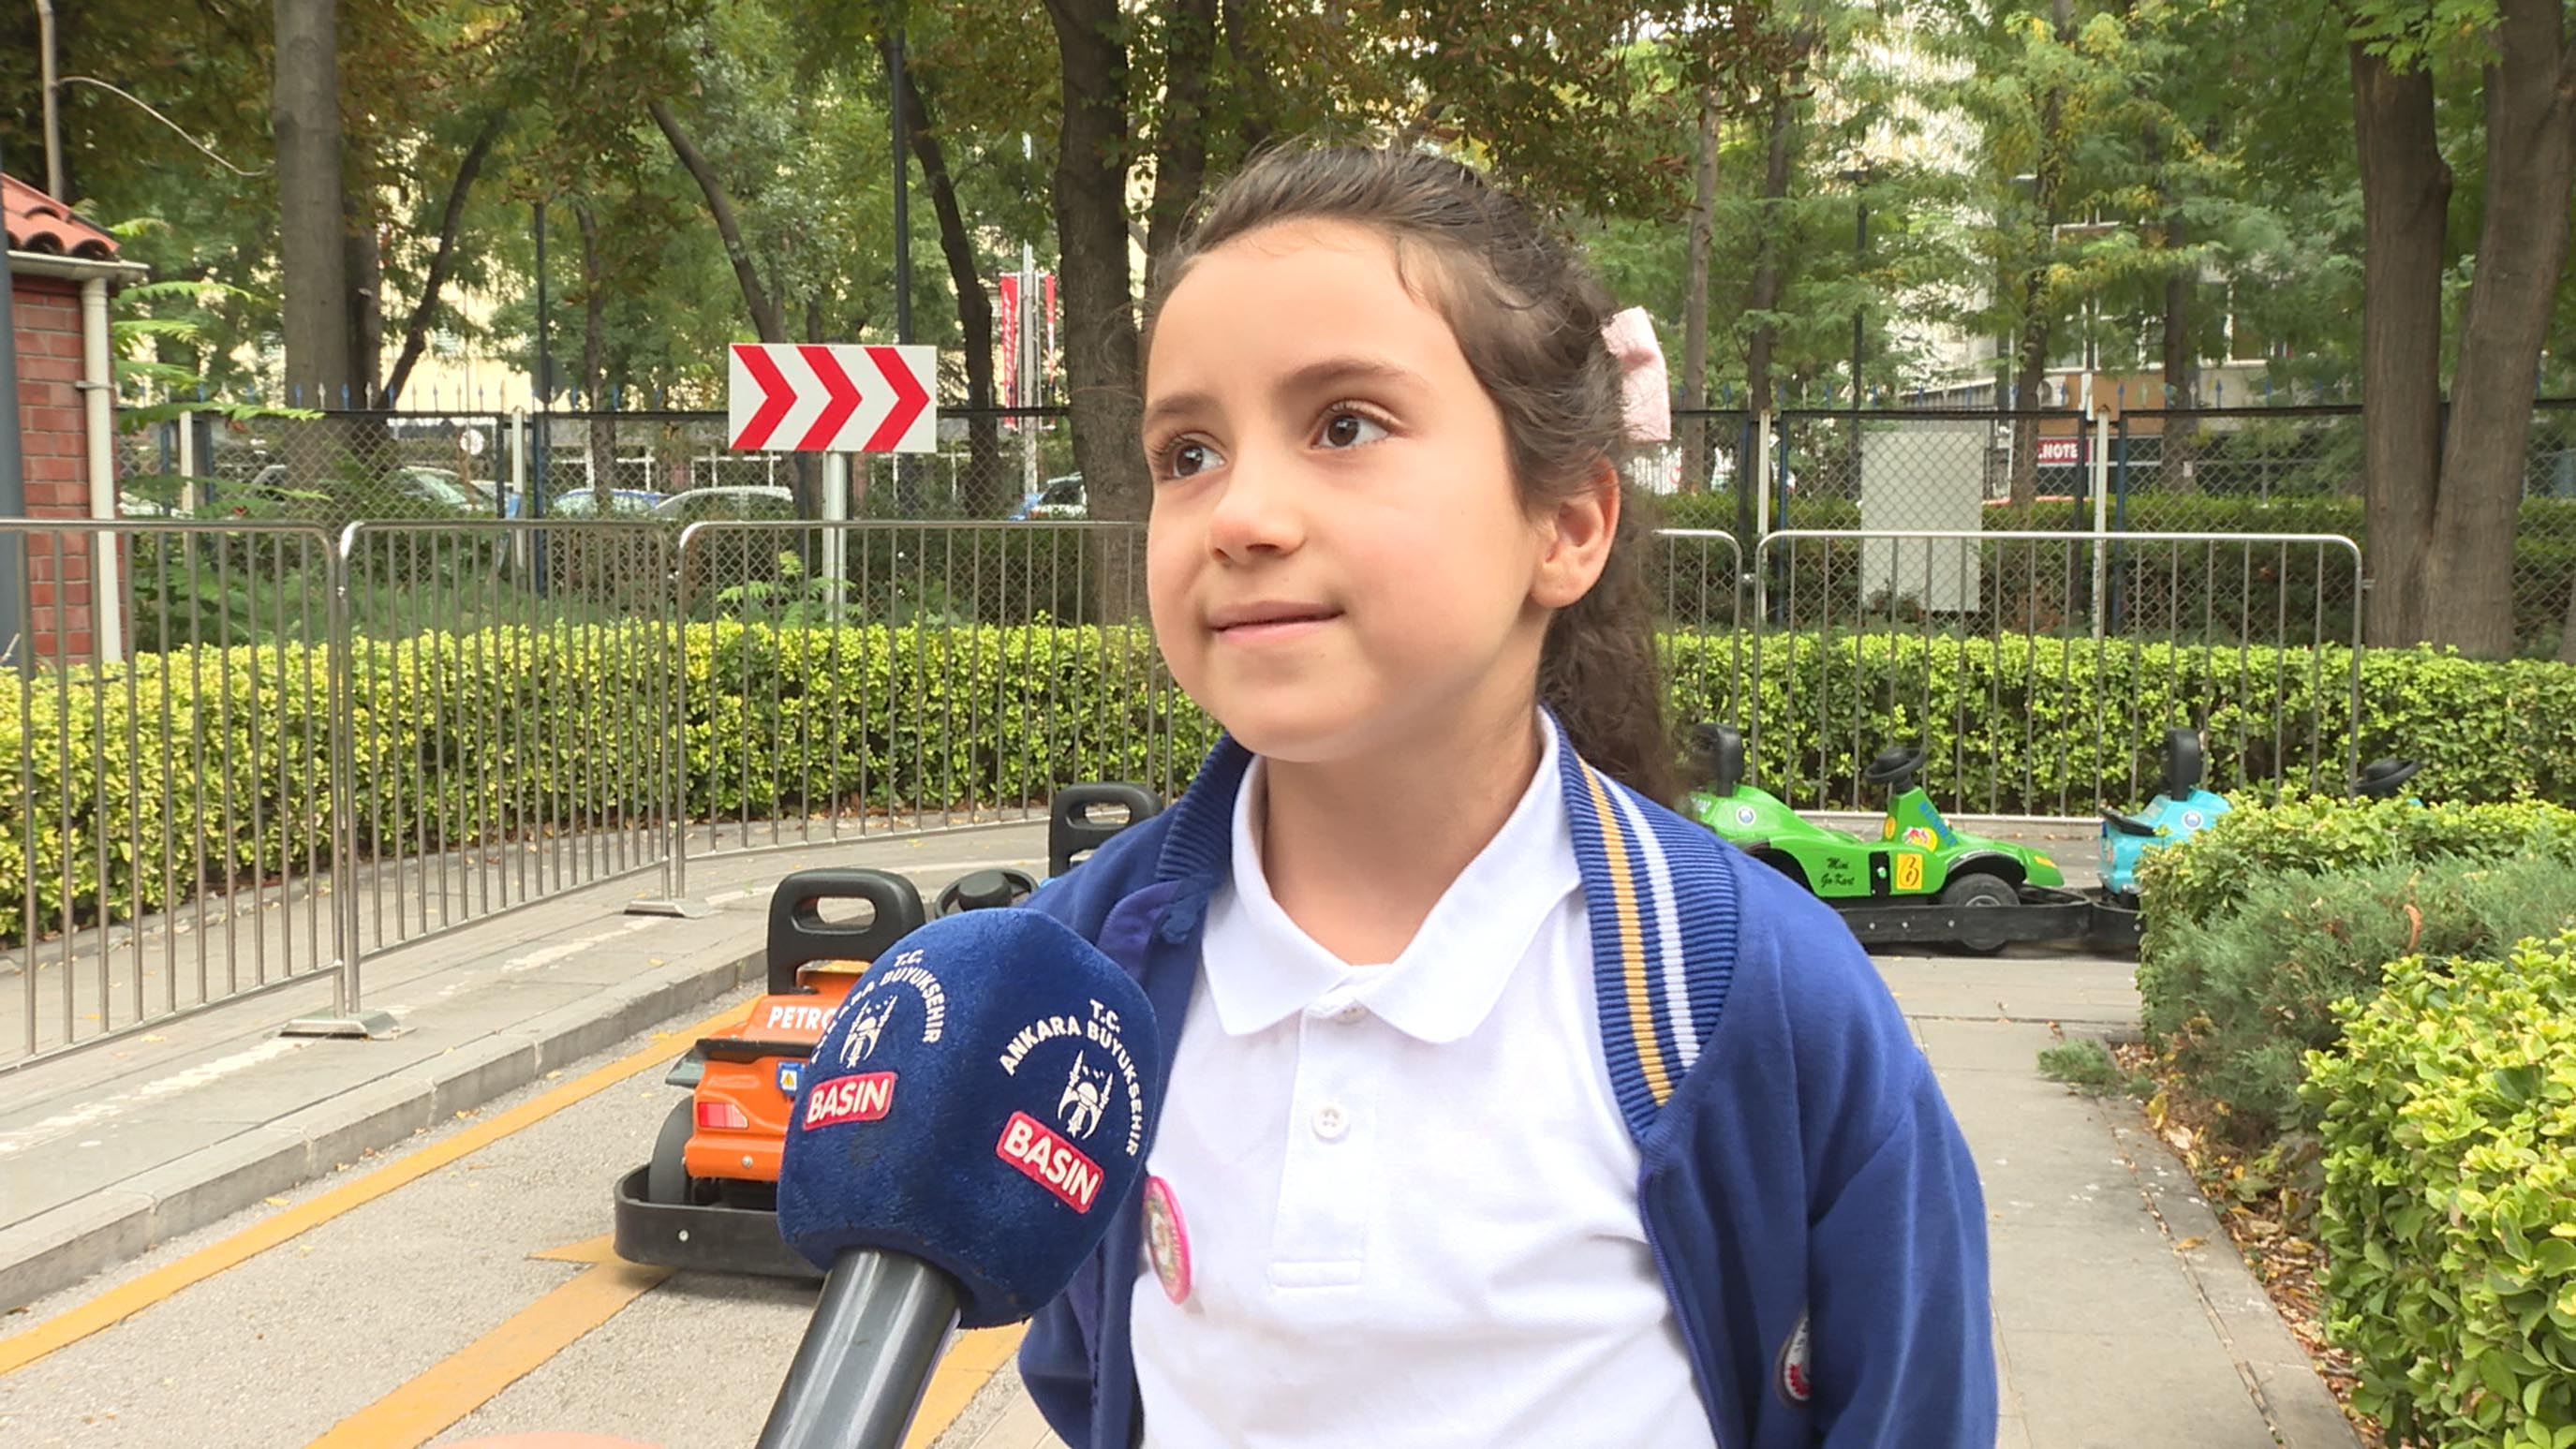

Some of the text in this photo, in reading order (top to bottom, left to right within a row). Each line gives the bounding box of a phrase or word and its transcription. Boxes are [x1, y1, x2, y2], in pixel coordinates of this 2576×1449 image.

[894, 949, 925, 967] T.C.
[1089, 998, 1120, 1033] T.C.
[999, 1015, 1082, 1076] ANKARA
[807, 1078, 890, 1123] BASIN
[1003, 1119, 1099, 1205] BASIN
